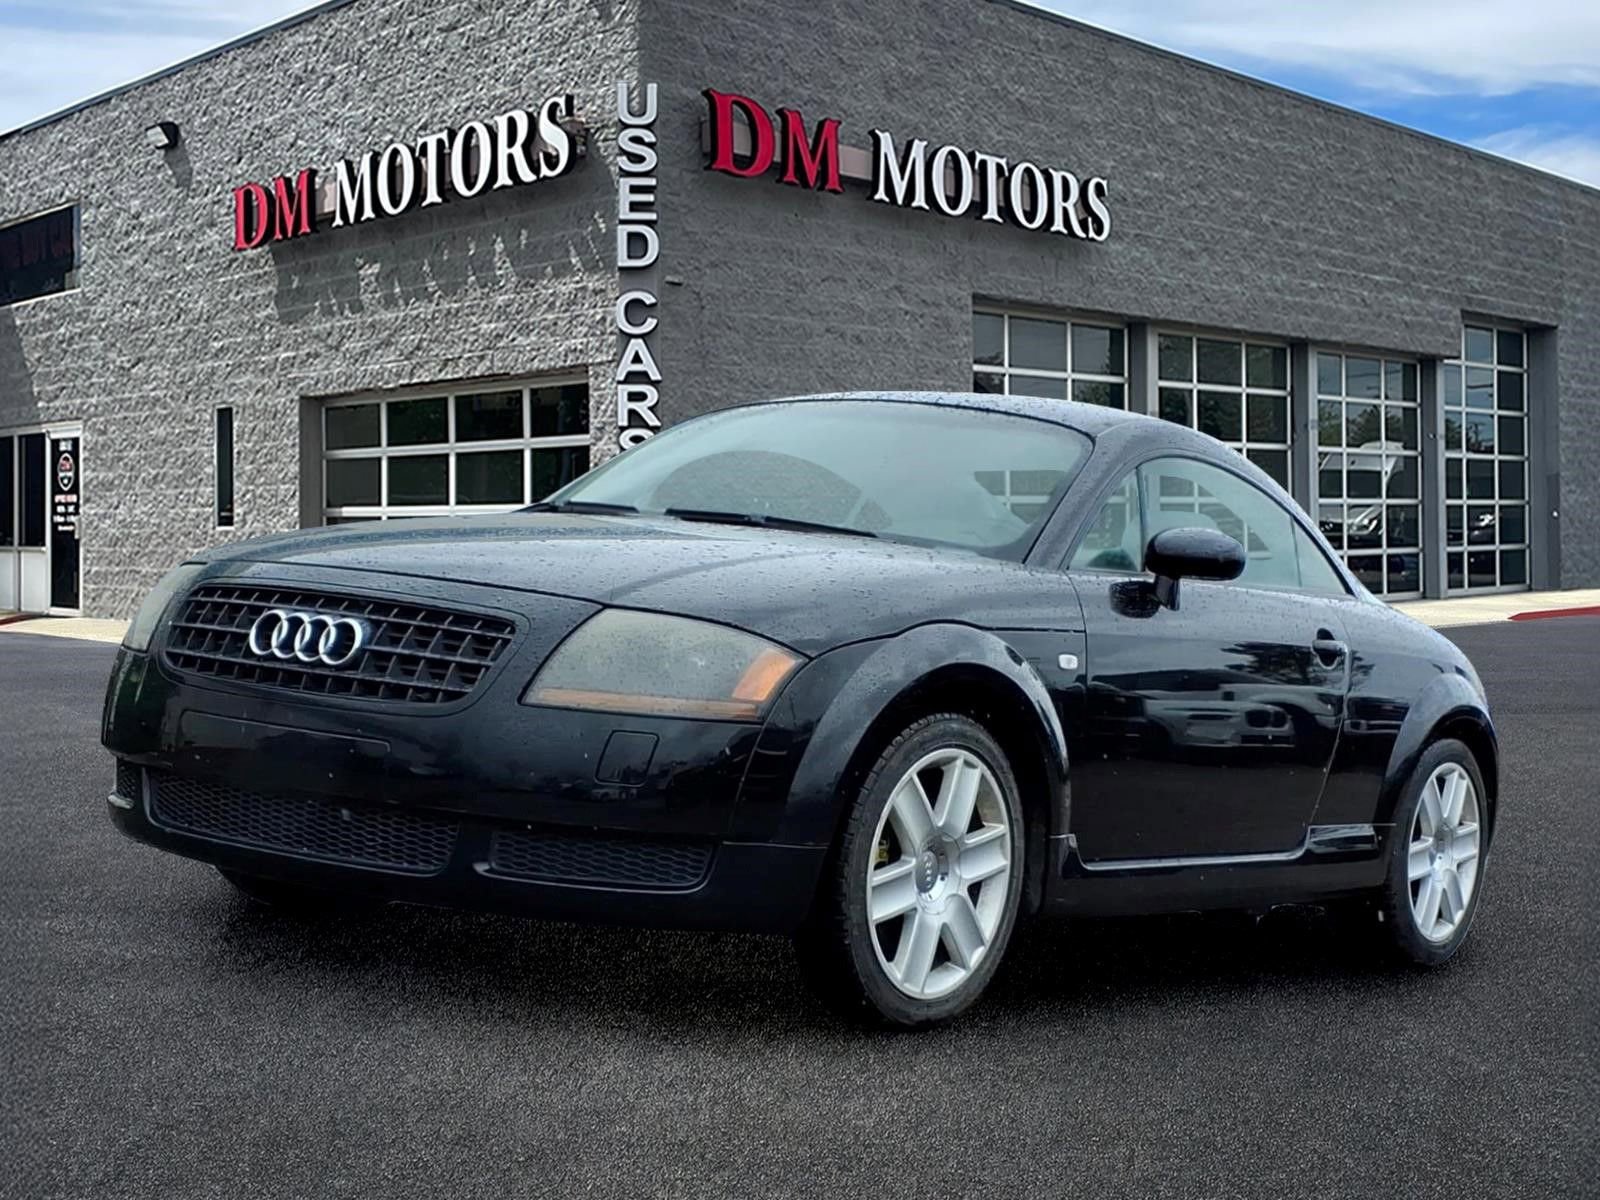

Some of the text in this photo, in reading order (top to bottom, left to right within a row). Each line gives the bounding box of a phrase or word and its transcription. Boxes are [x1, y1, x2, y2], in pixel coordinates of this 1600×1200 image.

[234, 97, 570, 250] DM MOTORS
[616, 81, 659, 268] USED
[706, 88, 1111, 242] DM MOTORS
